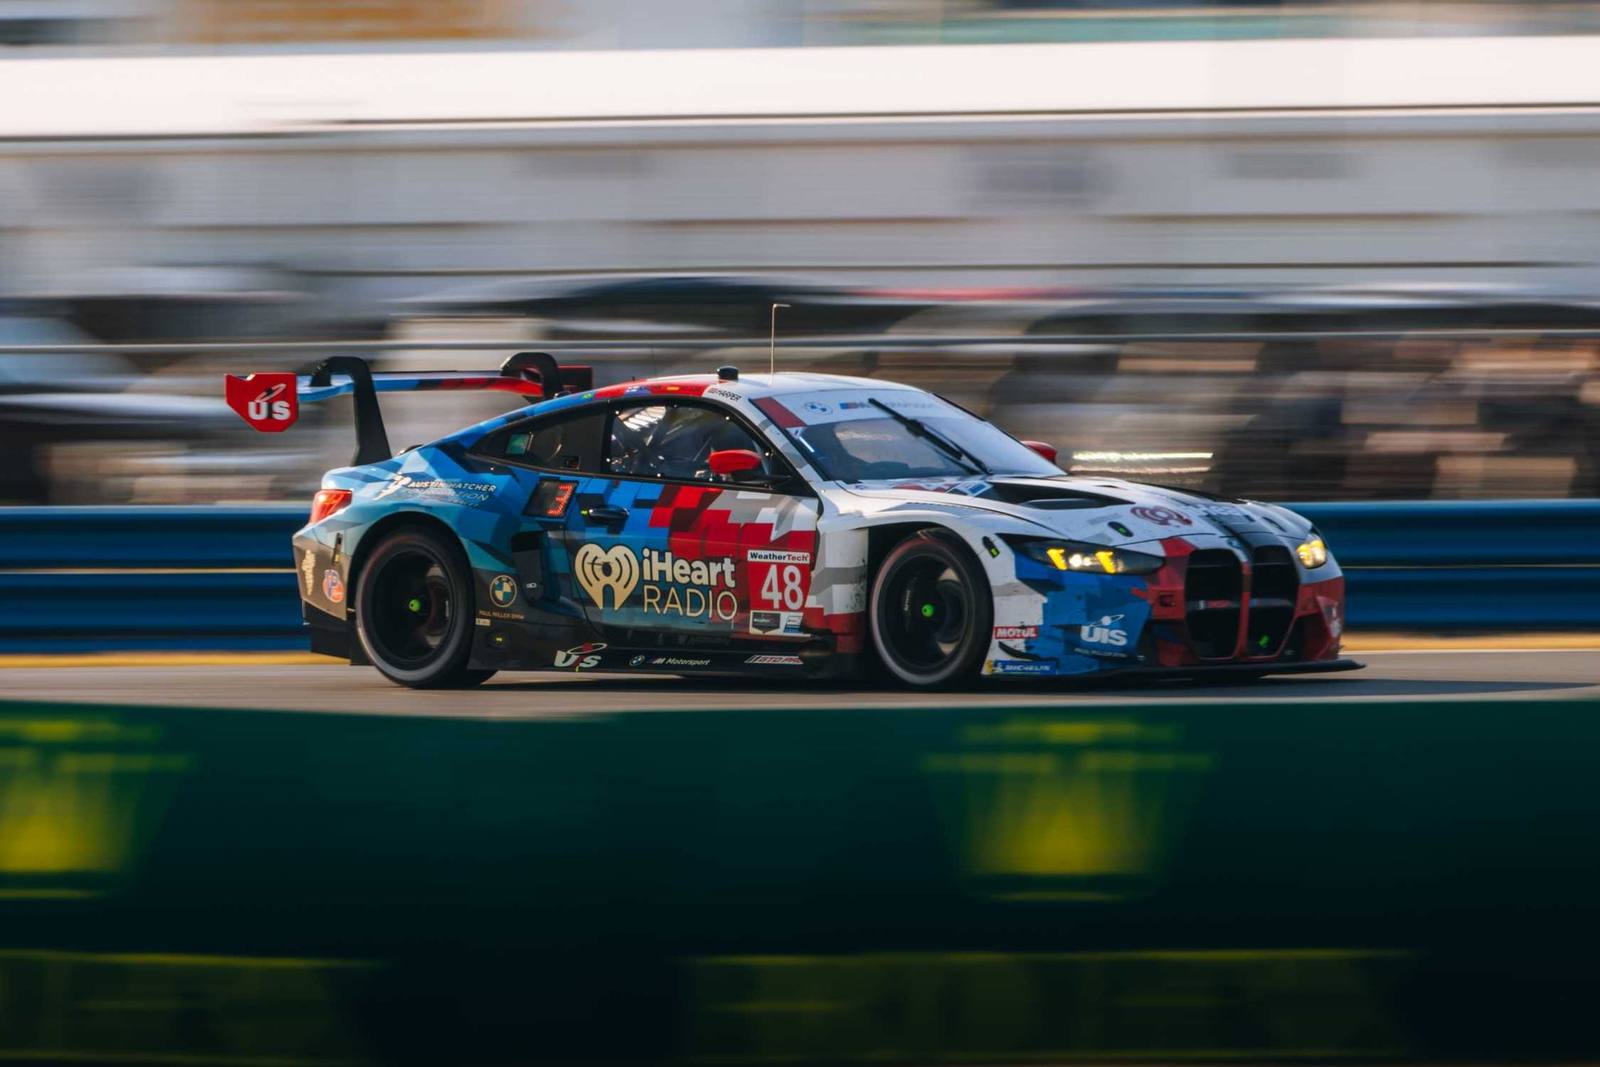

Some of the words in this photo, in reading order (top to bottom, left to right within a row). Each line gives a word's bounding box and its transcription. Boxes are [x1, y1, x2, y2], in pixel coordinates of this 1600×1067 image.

[546, 483, 573, 517] 3
[642, 547, 737, 588] iHeart
[750, 552, 809, 562] WeatherTech
[761, 564, 804, 610] 48
[643, 584, 738, 620] RADIO
[996, 627, 1038, 638] MOTUL
[1081, 625, 1128, 646] UIS
[666, 657, 711, 667] Motorsport
